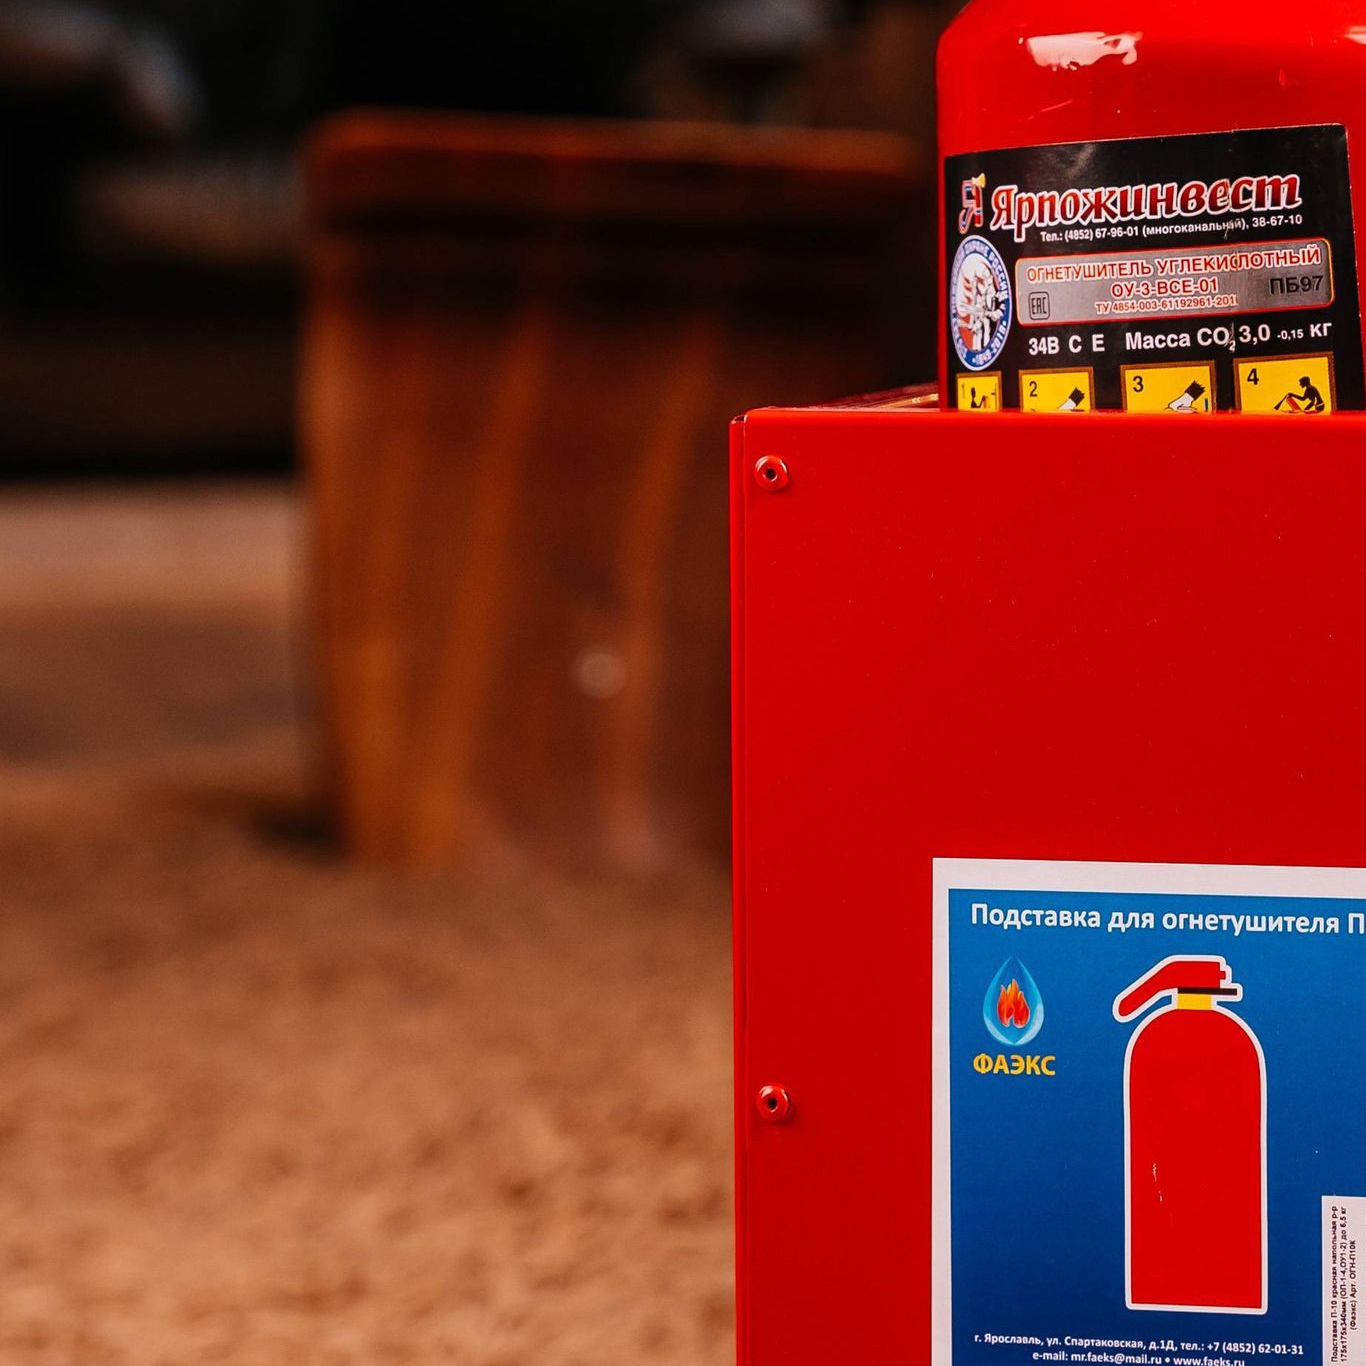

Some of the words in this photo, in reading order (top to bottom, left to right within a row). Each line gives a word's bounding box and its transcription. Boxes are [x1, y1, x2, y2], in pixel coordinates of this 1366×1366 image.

[990, 174, 1302, 242] Ярпожинвест
[1064, 228, 1093, 242] (4852)
[1095, 226, 1139, 239] 67-96-01
[1252, 214, 1303, 228] 38-67-10
[1026, 261, 1154, 283] ОГНЕТУШИТЕЛЬ
[1156, 244, 1321, 275] УГЛЕКИСЛОТНЫЙ
[1110, 276, 1219, 298] ОУ-3-ВСЕ-01
[1270, 275, 1324, 295] ПБ97
[1095, 302, 1110, 315] ТУ
[1125, 332, 1191, 351] Масса
[1238, 323, 1271, 346] 3,0
[1277, 328, 1304, 341] -0,15
[1132, 375, 1144, 392] 3
[1246, 368, 1259, 385] 4
[1029, 381, 1038, 397] 2
[971, 903, 1101, 930] Подставка
[1107, 911, 1155, 933] для
[1162, 912, 1339, 936] огнетушителя
[973, 1053, 1056, 1076] ФАЭКС
[1341, 1230, 1347, 1240] до
[1350, 1300, 1358, 1330] (Фаэкс)
[975, 1334, 982, 1343] г.
[984, 1333, 1044, 1346] Ярославль,
[1046, 1337, 1062, 1348] ул.
[1064, 1336, 1146, 1351] Спартаковская,
[1180, 1341, 1204, 1351] тел.:
[1207, 1341, 1219, 1352] +7
[1222, 1342, 1256, 1355] (4852)
[1258, 1343, 1304, 1355] 62-01-31
[1032, 1351, 1068, 1362] e-mail:
[1071, 1351, 1161, 1365] mr.faeks@mail.ru
